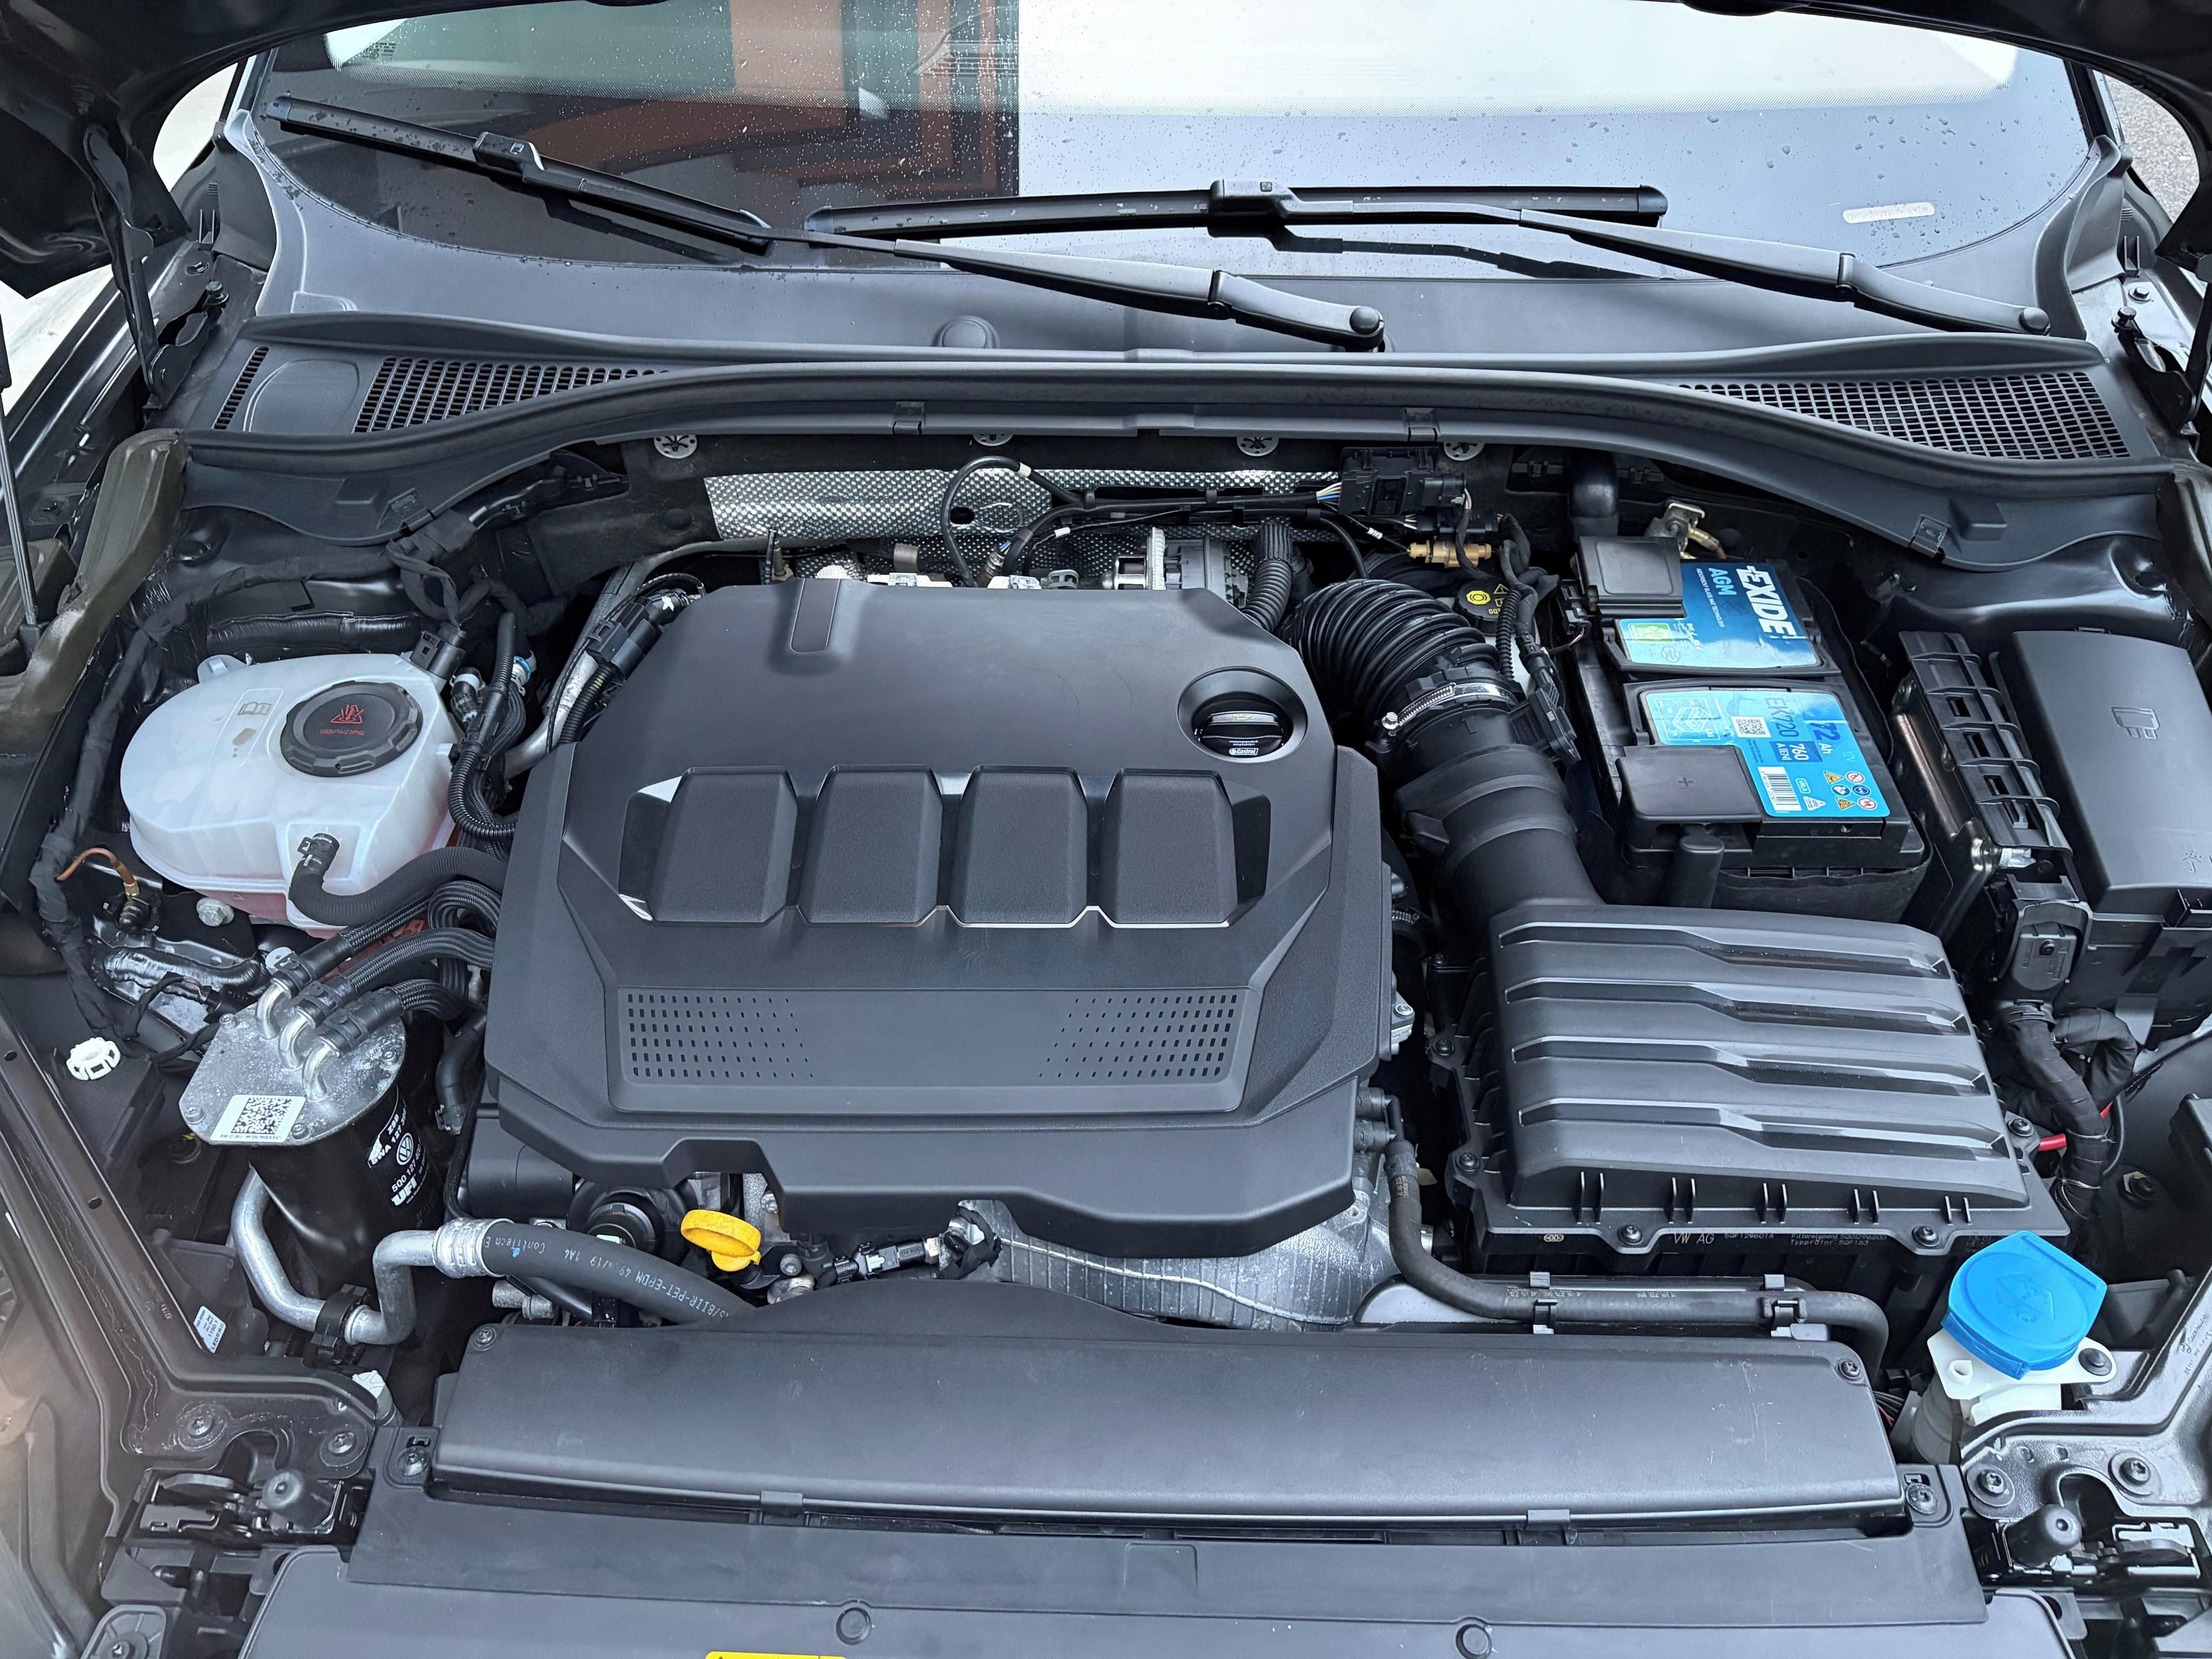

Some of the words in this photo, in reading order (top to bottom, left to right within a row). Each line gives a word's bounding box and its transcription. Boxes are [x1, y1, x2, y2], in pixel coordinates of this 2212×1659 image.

[1708, 568, 1737, 595] AGM
[1736, 565, 1797, 636] EXIDE
[1764, 697, 1799, 737] EK720
[1810, 721, 1840, 740] 72
[1790, 743, 1810, 761] 760
[1818, 743, 1833, 754] Ah
[1842, 751, 1858, 763] 12V
[387, 1114, 400, 1135] ZSB
[391, 1124, 402, 1143] 127
[392, 1174, 407, 1192] 5Q0
[406, 1158, 416, 1176] 127
[390, 1176, 418, 1206] UFI
[1674, 1233, 1691, 1245] VW
[1696, 1233, 1715, 1245] AG
[565, 1249, 579, 1262] 1A4
